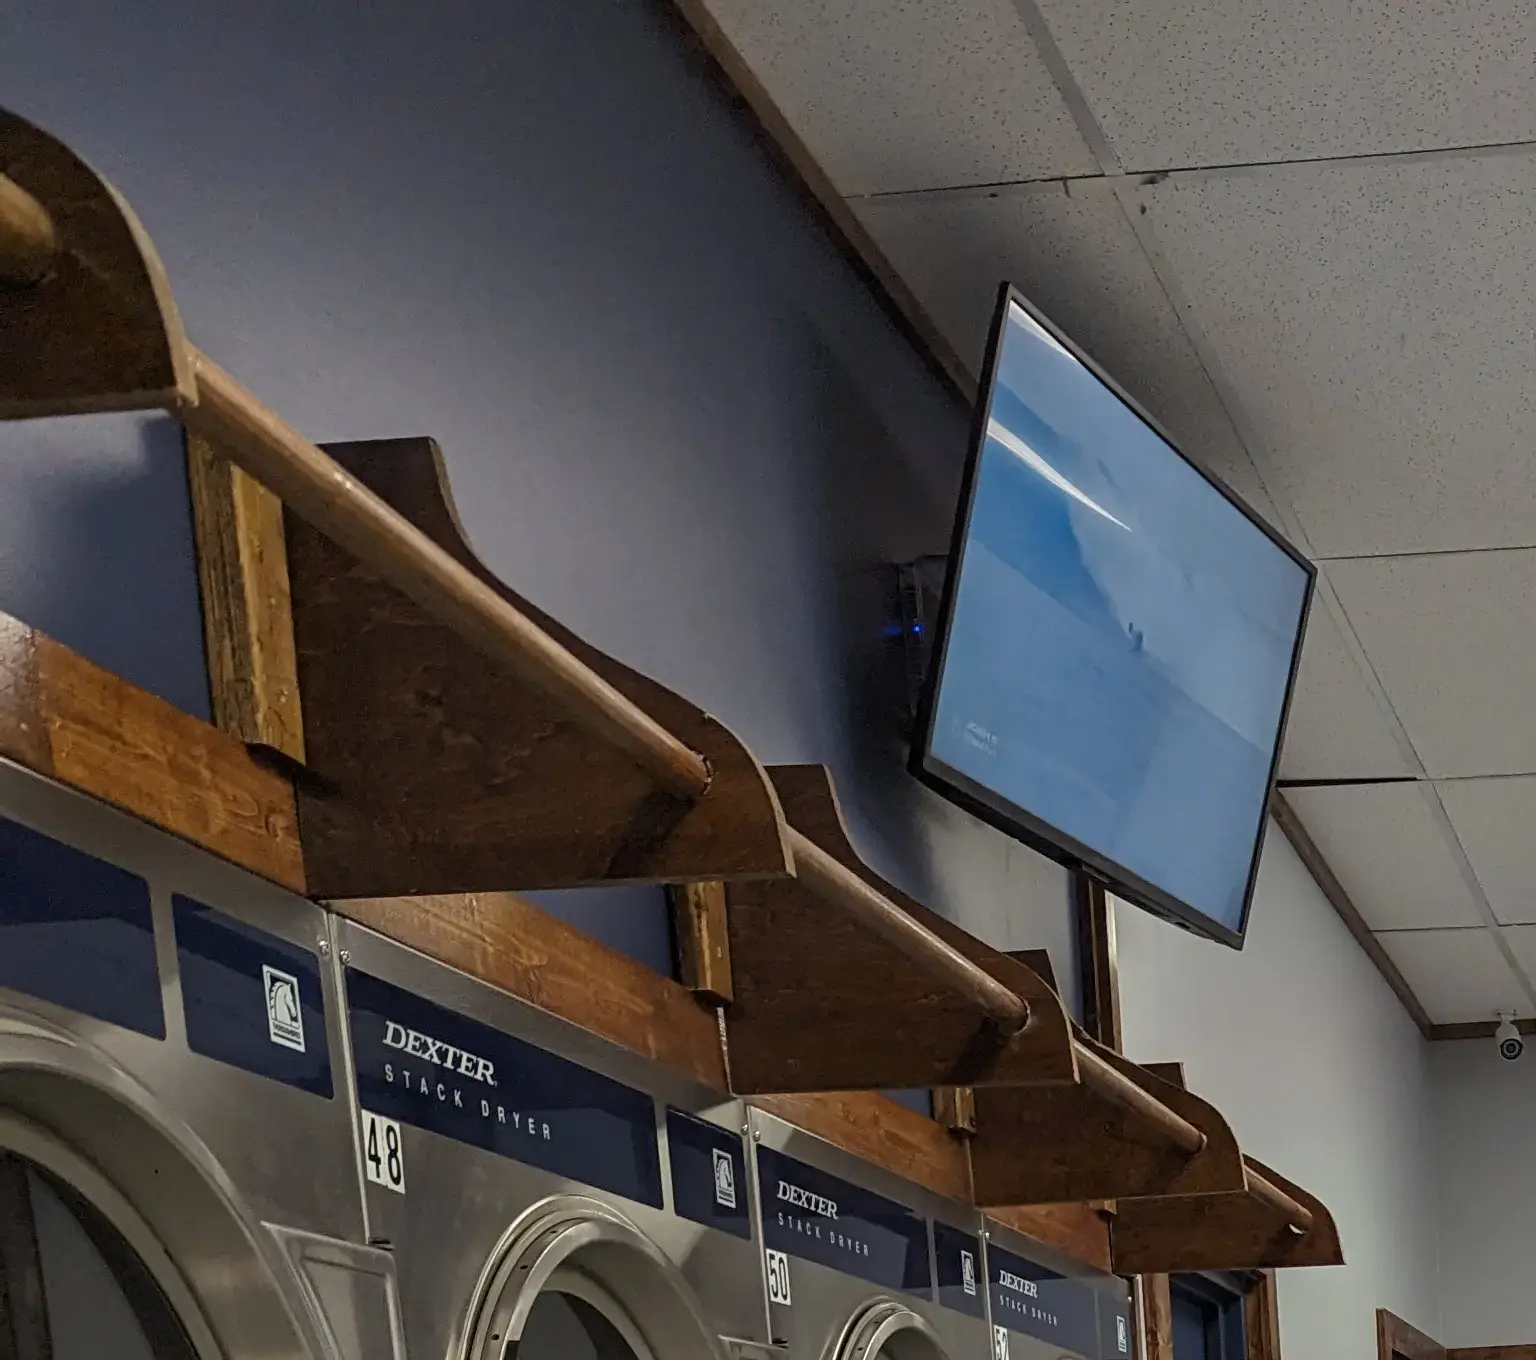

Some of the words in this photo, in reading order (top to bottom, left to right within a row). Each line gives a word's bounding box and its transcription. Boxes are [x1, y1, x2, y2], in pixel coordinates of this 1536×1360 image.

[382, 1020, 496, 1087] DEXTER
[384, 1063, 463, 1108] STACK
[481, 1100, 551, 1140] DRYER
[367, 1117, 401, 1186] 48
[777, 1180, 839, 1220] DEXTER
[778, 1212, 821, 1239] STACK
[829, 1231, 869, 1257] DRYER
[768, 1252, 788, 1302] 50
[999, 1269, 1038, 1299] DEXTER
